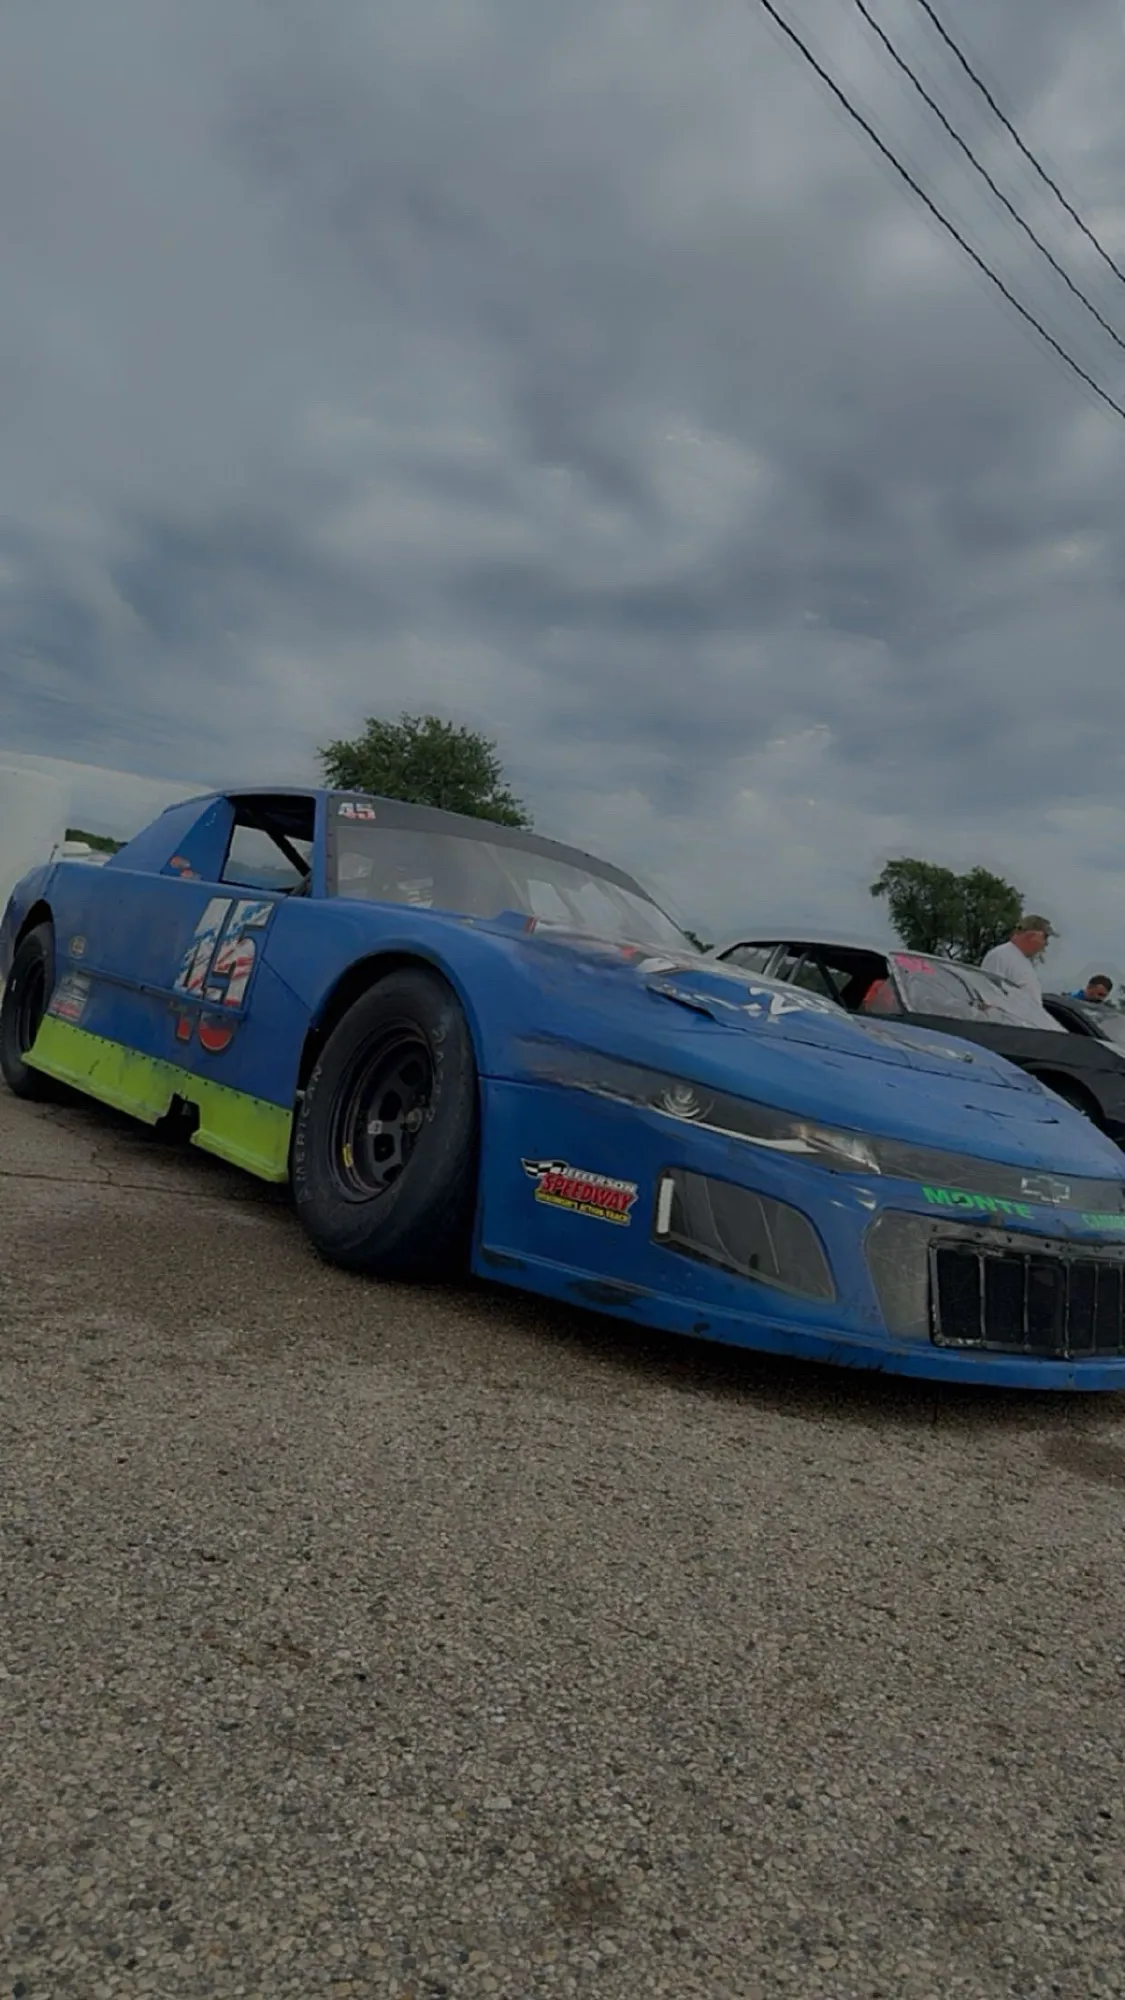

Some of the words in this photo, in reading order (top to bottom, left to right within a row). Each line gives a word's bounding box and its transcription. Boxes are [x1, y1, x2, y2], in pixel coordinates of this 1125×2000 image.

[338, 802, 376, 820] 45
[173, 896, 275, 1052] 45
[541, 1173, 633, 1211] SPEEDWAY
[922, 1186, 1035, 1220] MONTE
